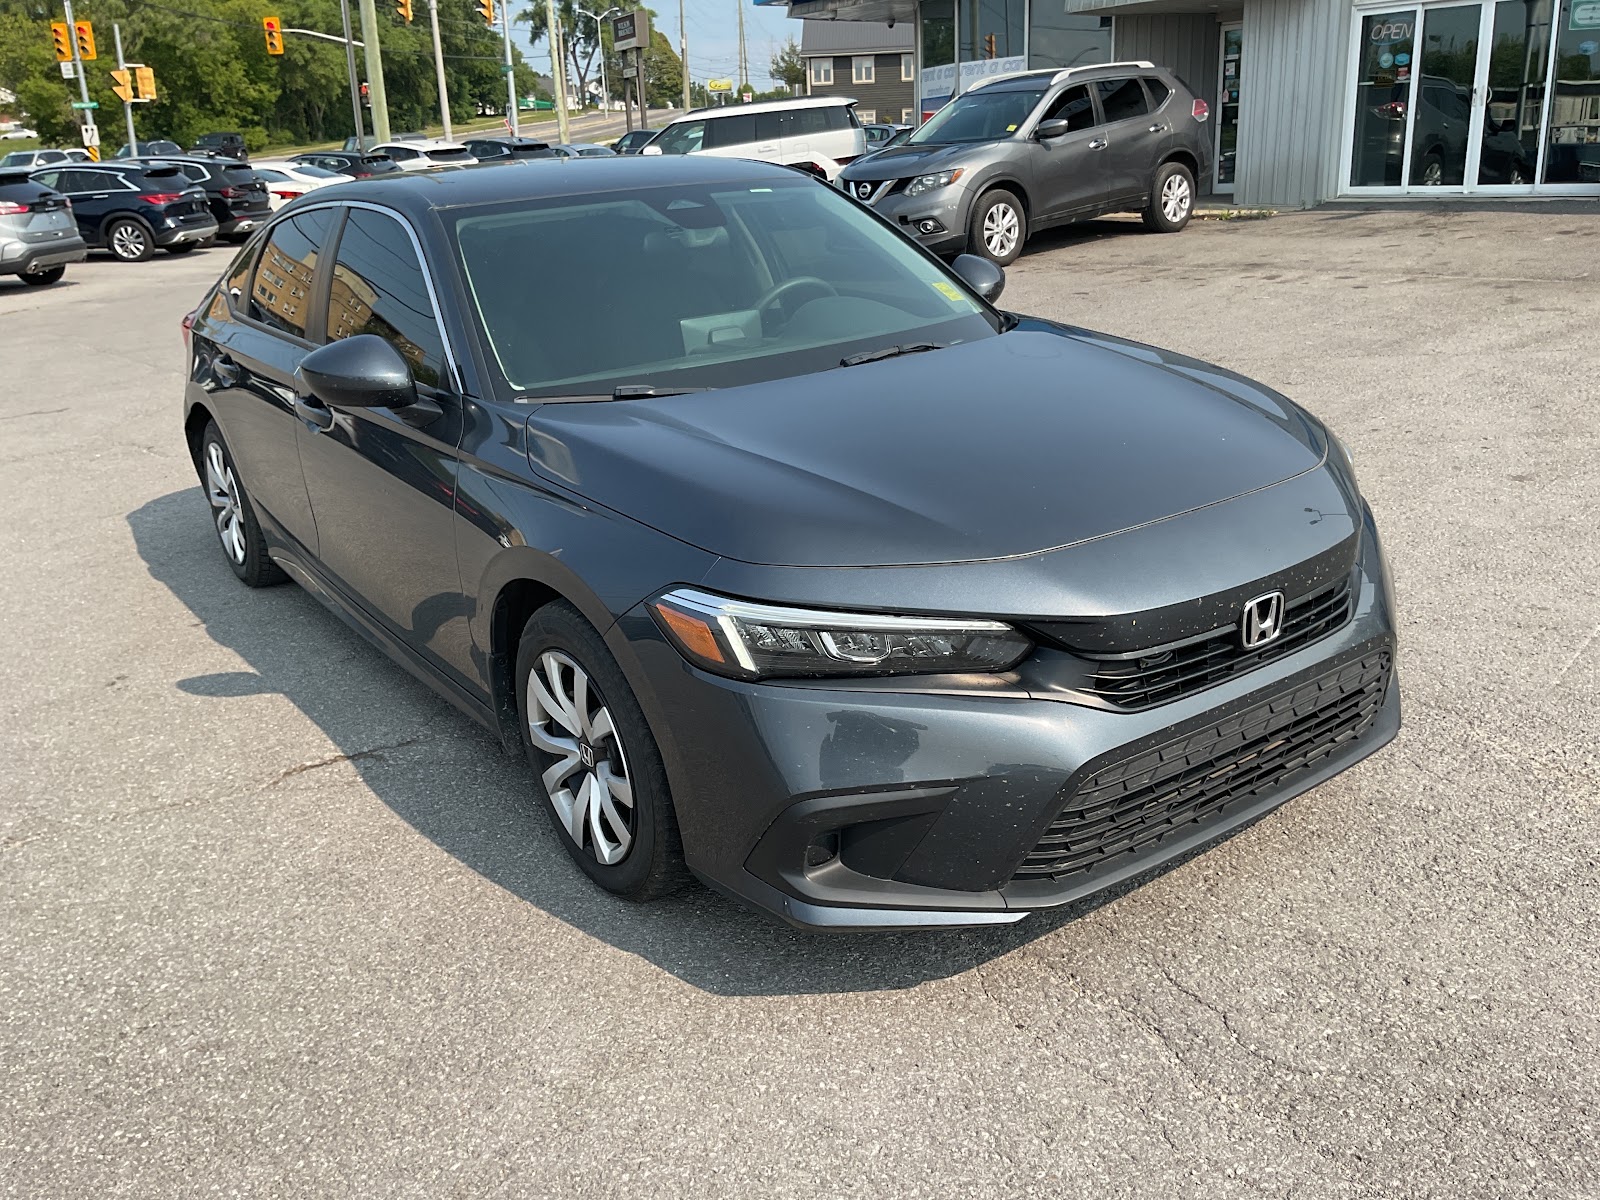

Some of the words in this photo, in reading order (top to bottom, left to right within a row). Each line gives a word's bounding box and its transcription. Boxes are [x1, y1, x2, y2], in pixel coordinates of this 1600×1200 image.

[1371, 22, 1414, 40] OPEN
[960, 60, 986, 76] rent
[989, 61, 999, 73] a
[1003, 59, 1024, 72] car
